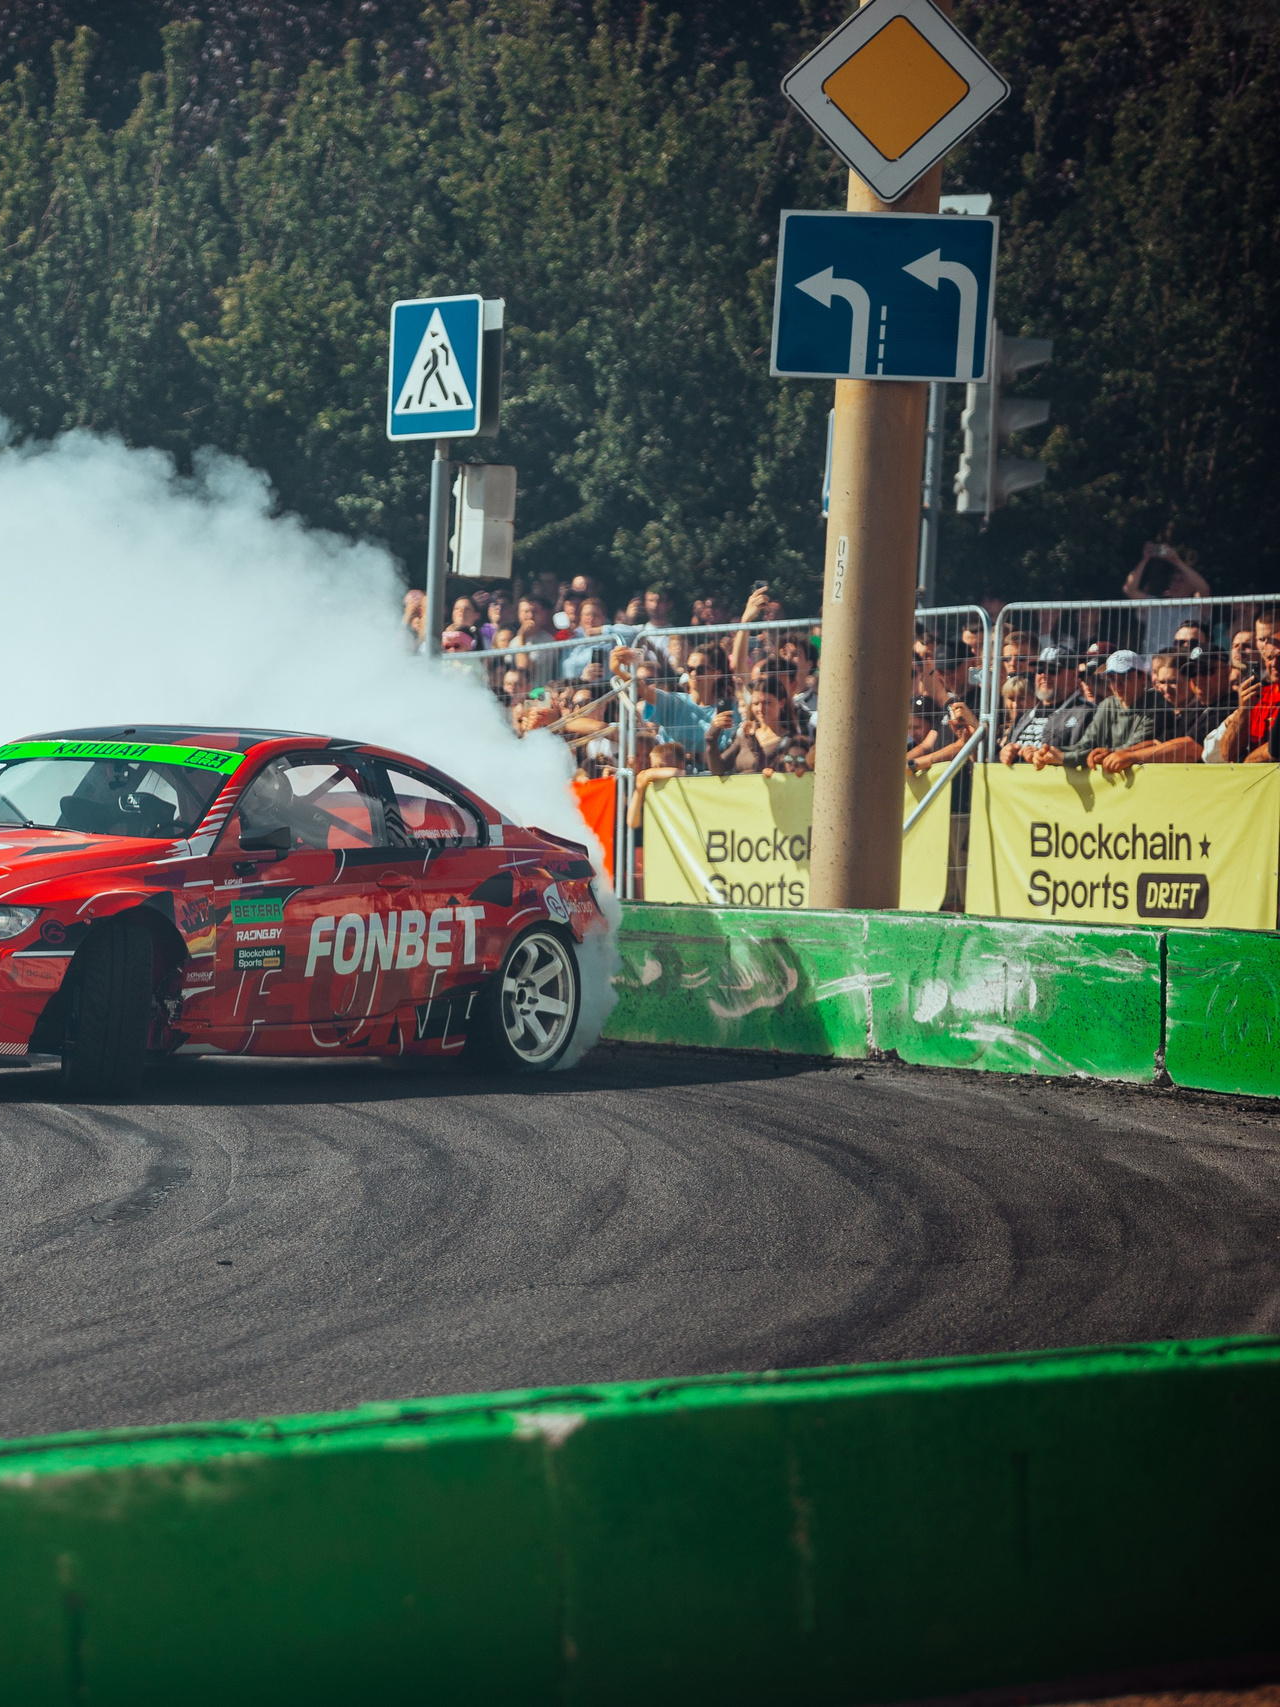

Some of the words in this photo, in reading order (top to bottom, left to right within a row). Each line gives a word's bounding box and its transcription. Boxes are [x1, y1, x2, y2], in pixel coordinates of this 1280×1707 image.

[835, 539, 846, 599] 052
[1030, 822, 1192, 861] Blockchain
[1028, 869, 1129, 915] Sports
[1145, 881, 1201, 910] DRIFT
[238, 948, 277, 959] Blockchain
[304, 905, 486, 977] FONBET
[238, 959, 262, 969] Sports
